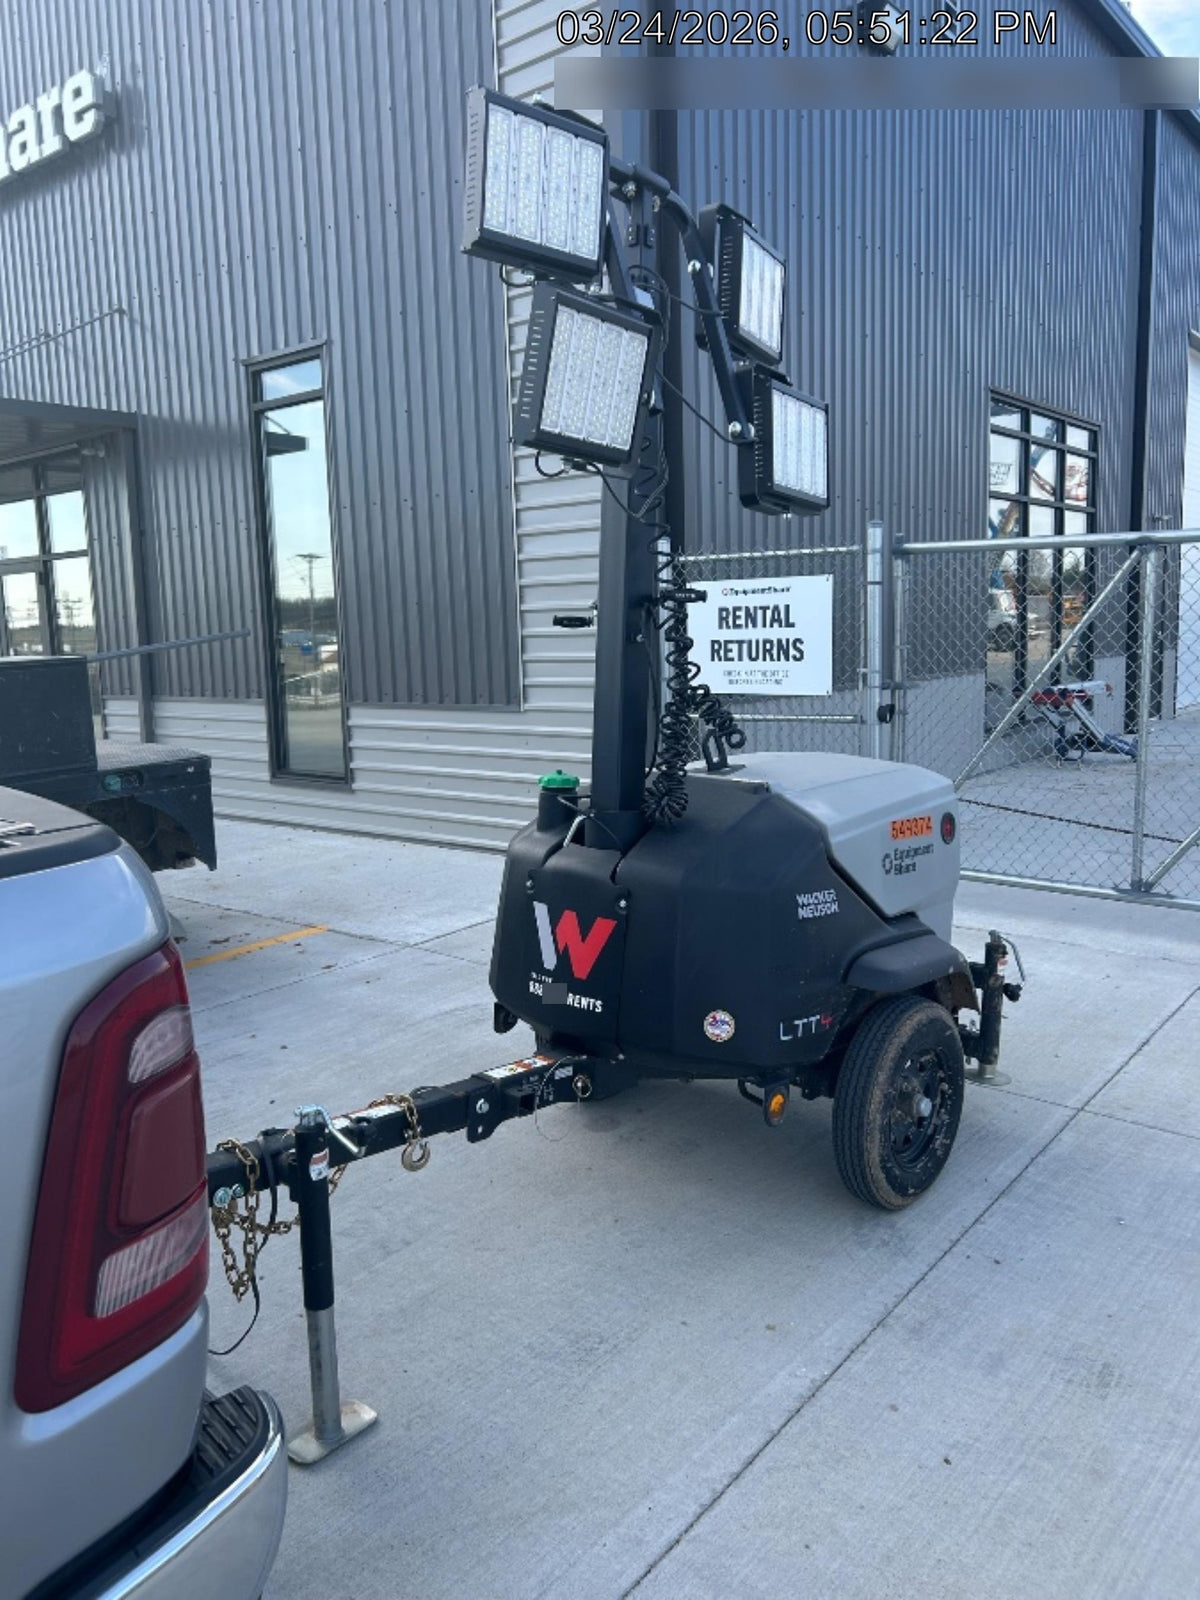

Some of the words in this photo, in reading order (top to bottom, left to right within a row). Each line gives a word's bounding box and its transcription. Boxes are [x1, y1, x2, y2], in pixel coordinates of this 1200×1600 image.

[0, 68, 95, 179] are
[718, 604, 795, 630] RENTAL
[710, 638, 805, 662] RETURNS
